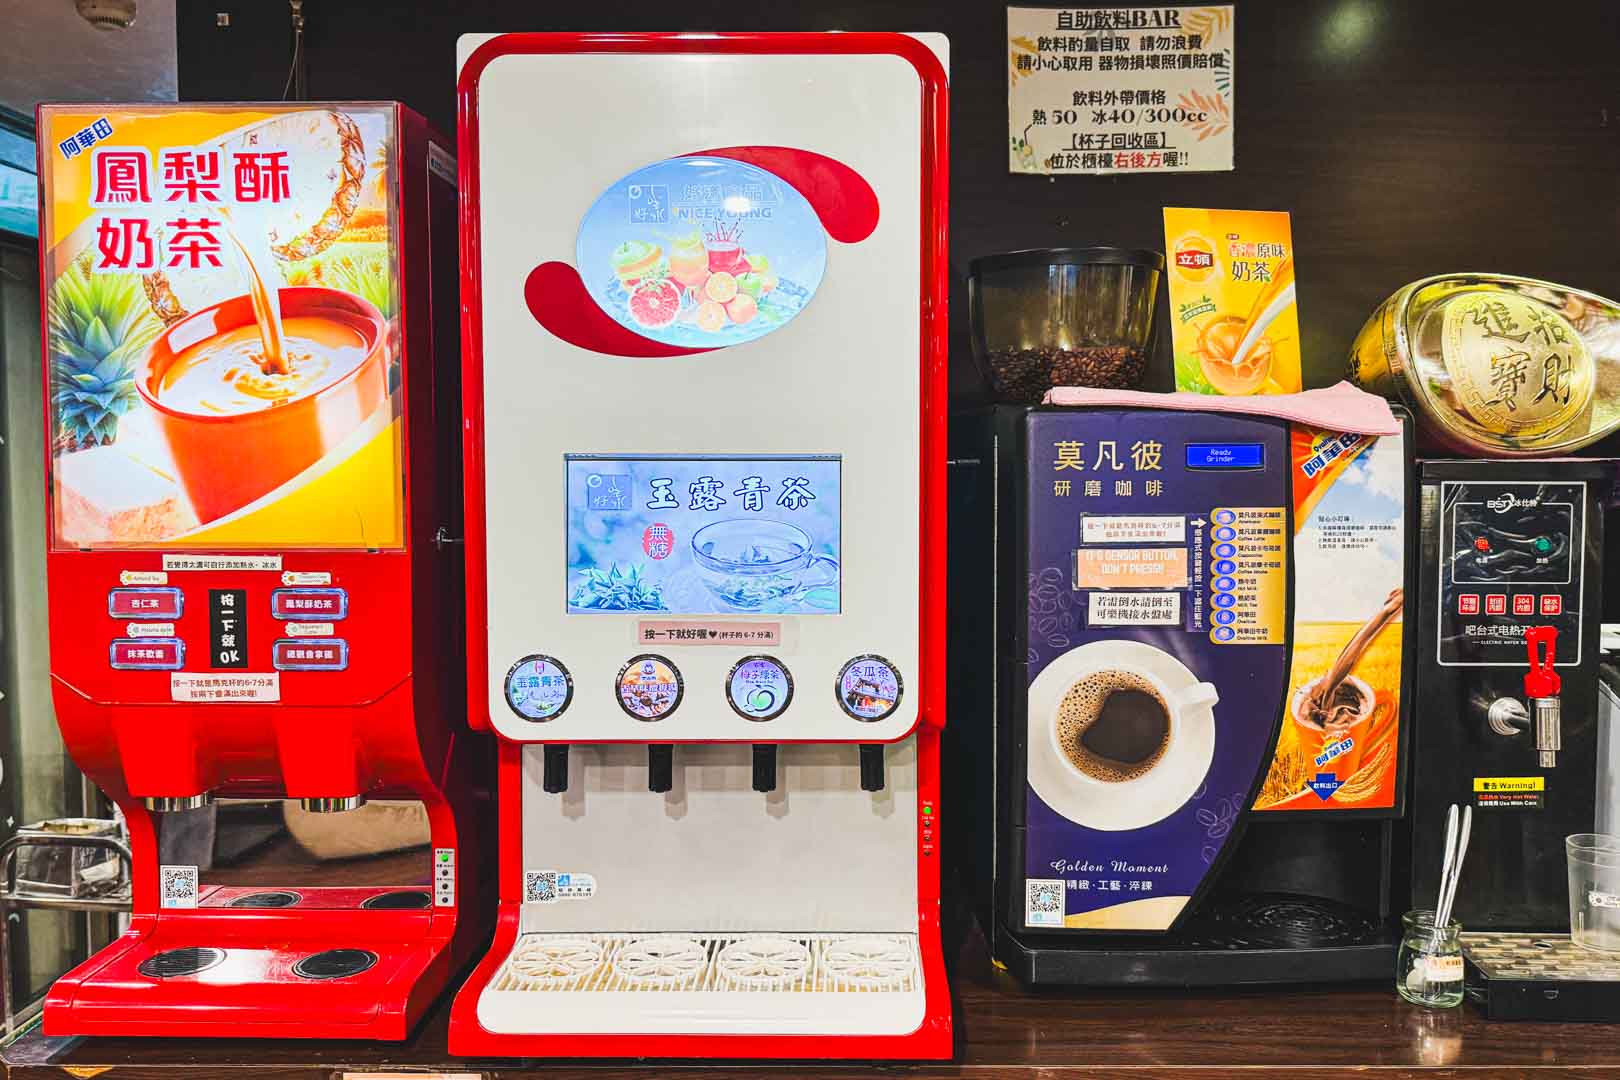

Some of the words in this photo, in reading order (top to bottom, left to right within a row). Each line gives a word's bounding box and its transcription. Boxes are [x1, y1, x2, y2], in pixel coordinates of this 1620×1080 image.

[1057, 10, 1181, 29] 自助飲料BAR
[1037, 36, 1130, 53] 飲料酌量自取
[1140, 35, 1203, 51] 請勿浪費
[1017, 56, 1093, 72] 請小心取用
[1098, 53, 1225, 71] 器物損壞照價賠償
[1072, 90, 1167, 106] 飲料外帶價格
[1032, 110, 1047, 125] 熱
[1053, 110, 1078, 125] 50
[1092, 108, 1208, 126] 冰40/300cc
[59, 117, 114, 159] 阿華田
[1070, 132, 1168, 149] 【杯子回收區】
[95, 151, 291, 203] 鳳梨酥
[679, 207, 713, 218] NICE
[96, 217, 223, 270] 奶茶
[1230, 242, 1286, 258] 香濃原味
[1178, 253, 1211, 266] 立頓
[1231, 261, 1271, 282] 奶茶
[1053, 440, 1164, 472] 莫凡彼
[1206, 455, 1234, 463] Grinder
[646, 475, 817, 512] 玉露青茶
[1053, 480, 1164, 497] 研磨咖啡
[648, 527, 670, 559] 無糖
[131, 599, 160, 608] 杏仁茶
[851, 666, 890, 678] 冬瓜茶
[516, 675, 565, 688] 玉露青茶
[1050, 859, 1105, 874] Golden
[1110, 860, 1169, 873] Moment
